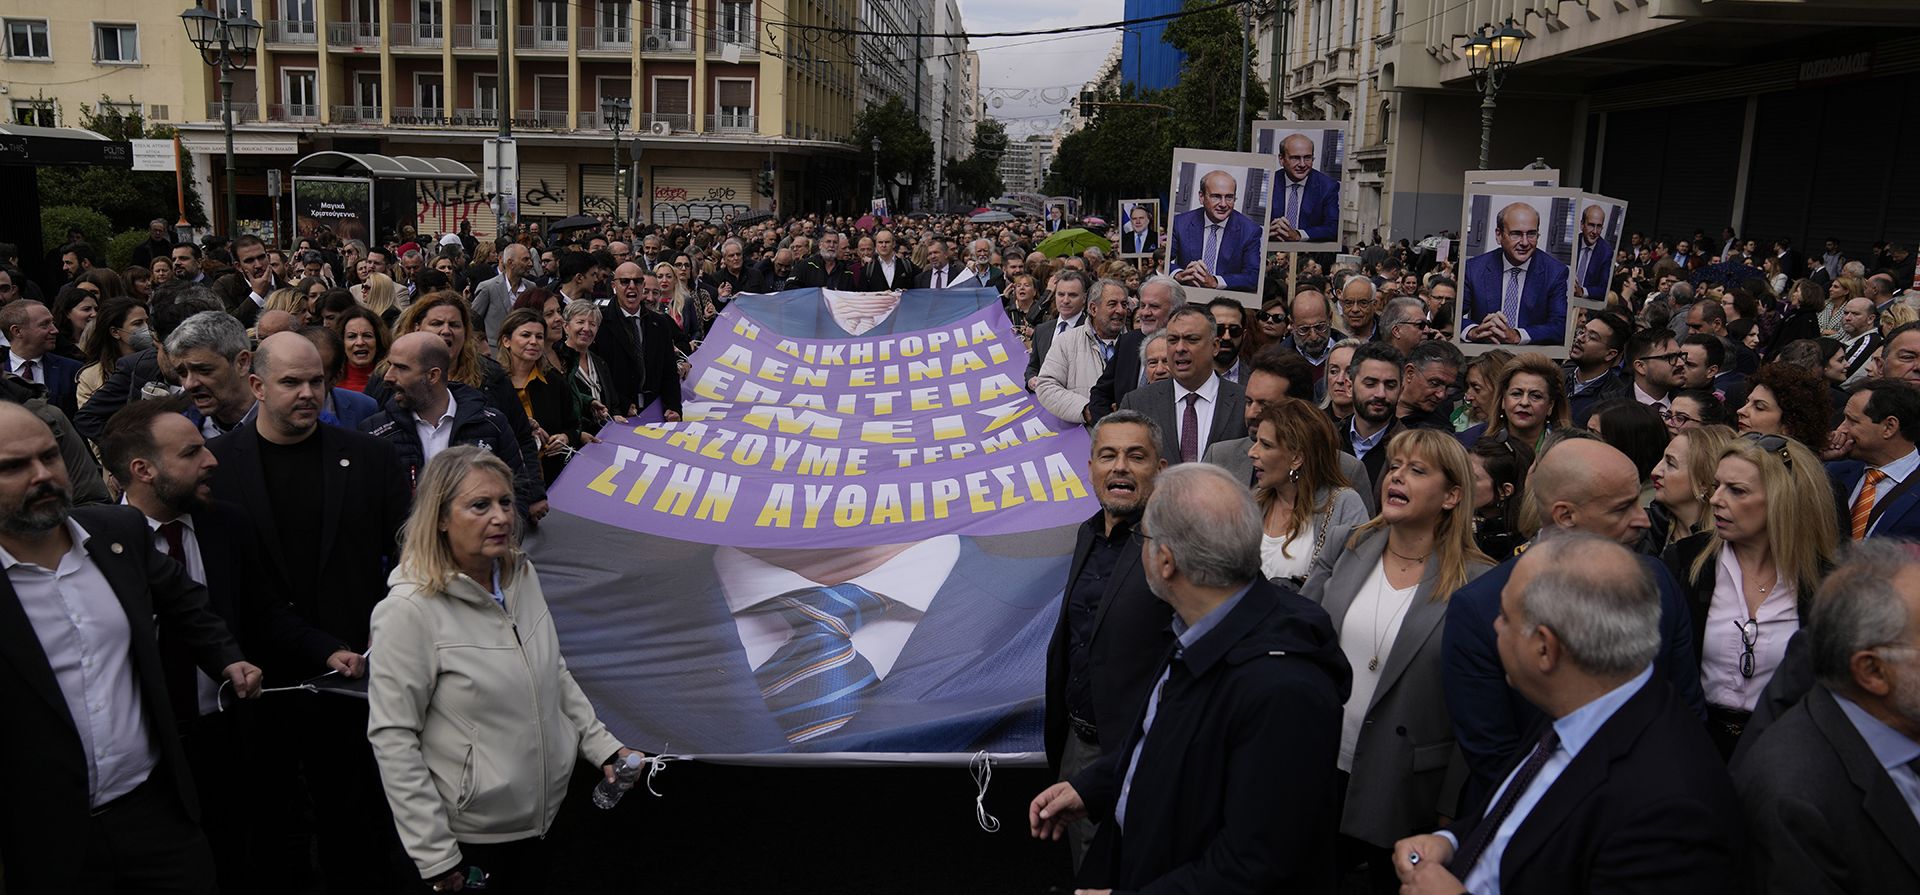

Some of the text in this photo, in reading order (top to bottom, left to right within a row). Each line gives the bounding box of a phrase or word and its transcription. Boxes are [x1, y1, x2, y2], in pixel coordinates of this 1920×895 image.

[466, 117, 548, 128] ΕΣΩΤΡΙΚΩΝ
[311, 209, 356, 218] Χριστούγεννα
[321, 202, 345, 210] Μαγικά
[714, 343, 1009, 387] ΔΕΝ ΕΙΝΑΙ
[733, 317, 997, 365] Η ΔΙΚΗΓΟΡΙΑ
[693, 366, 1023, 416] ΕΠΑΙΤΕΙΑ
[682, 396, 1035, 444] ΕΜΕΙΣ
[893, 416, 1059, 468] ΤΕΡΜΑ
[586, 445, 1089, 528] ΣΤΗΝ ΑΥΘΑΙΡΕΣΙΑ
